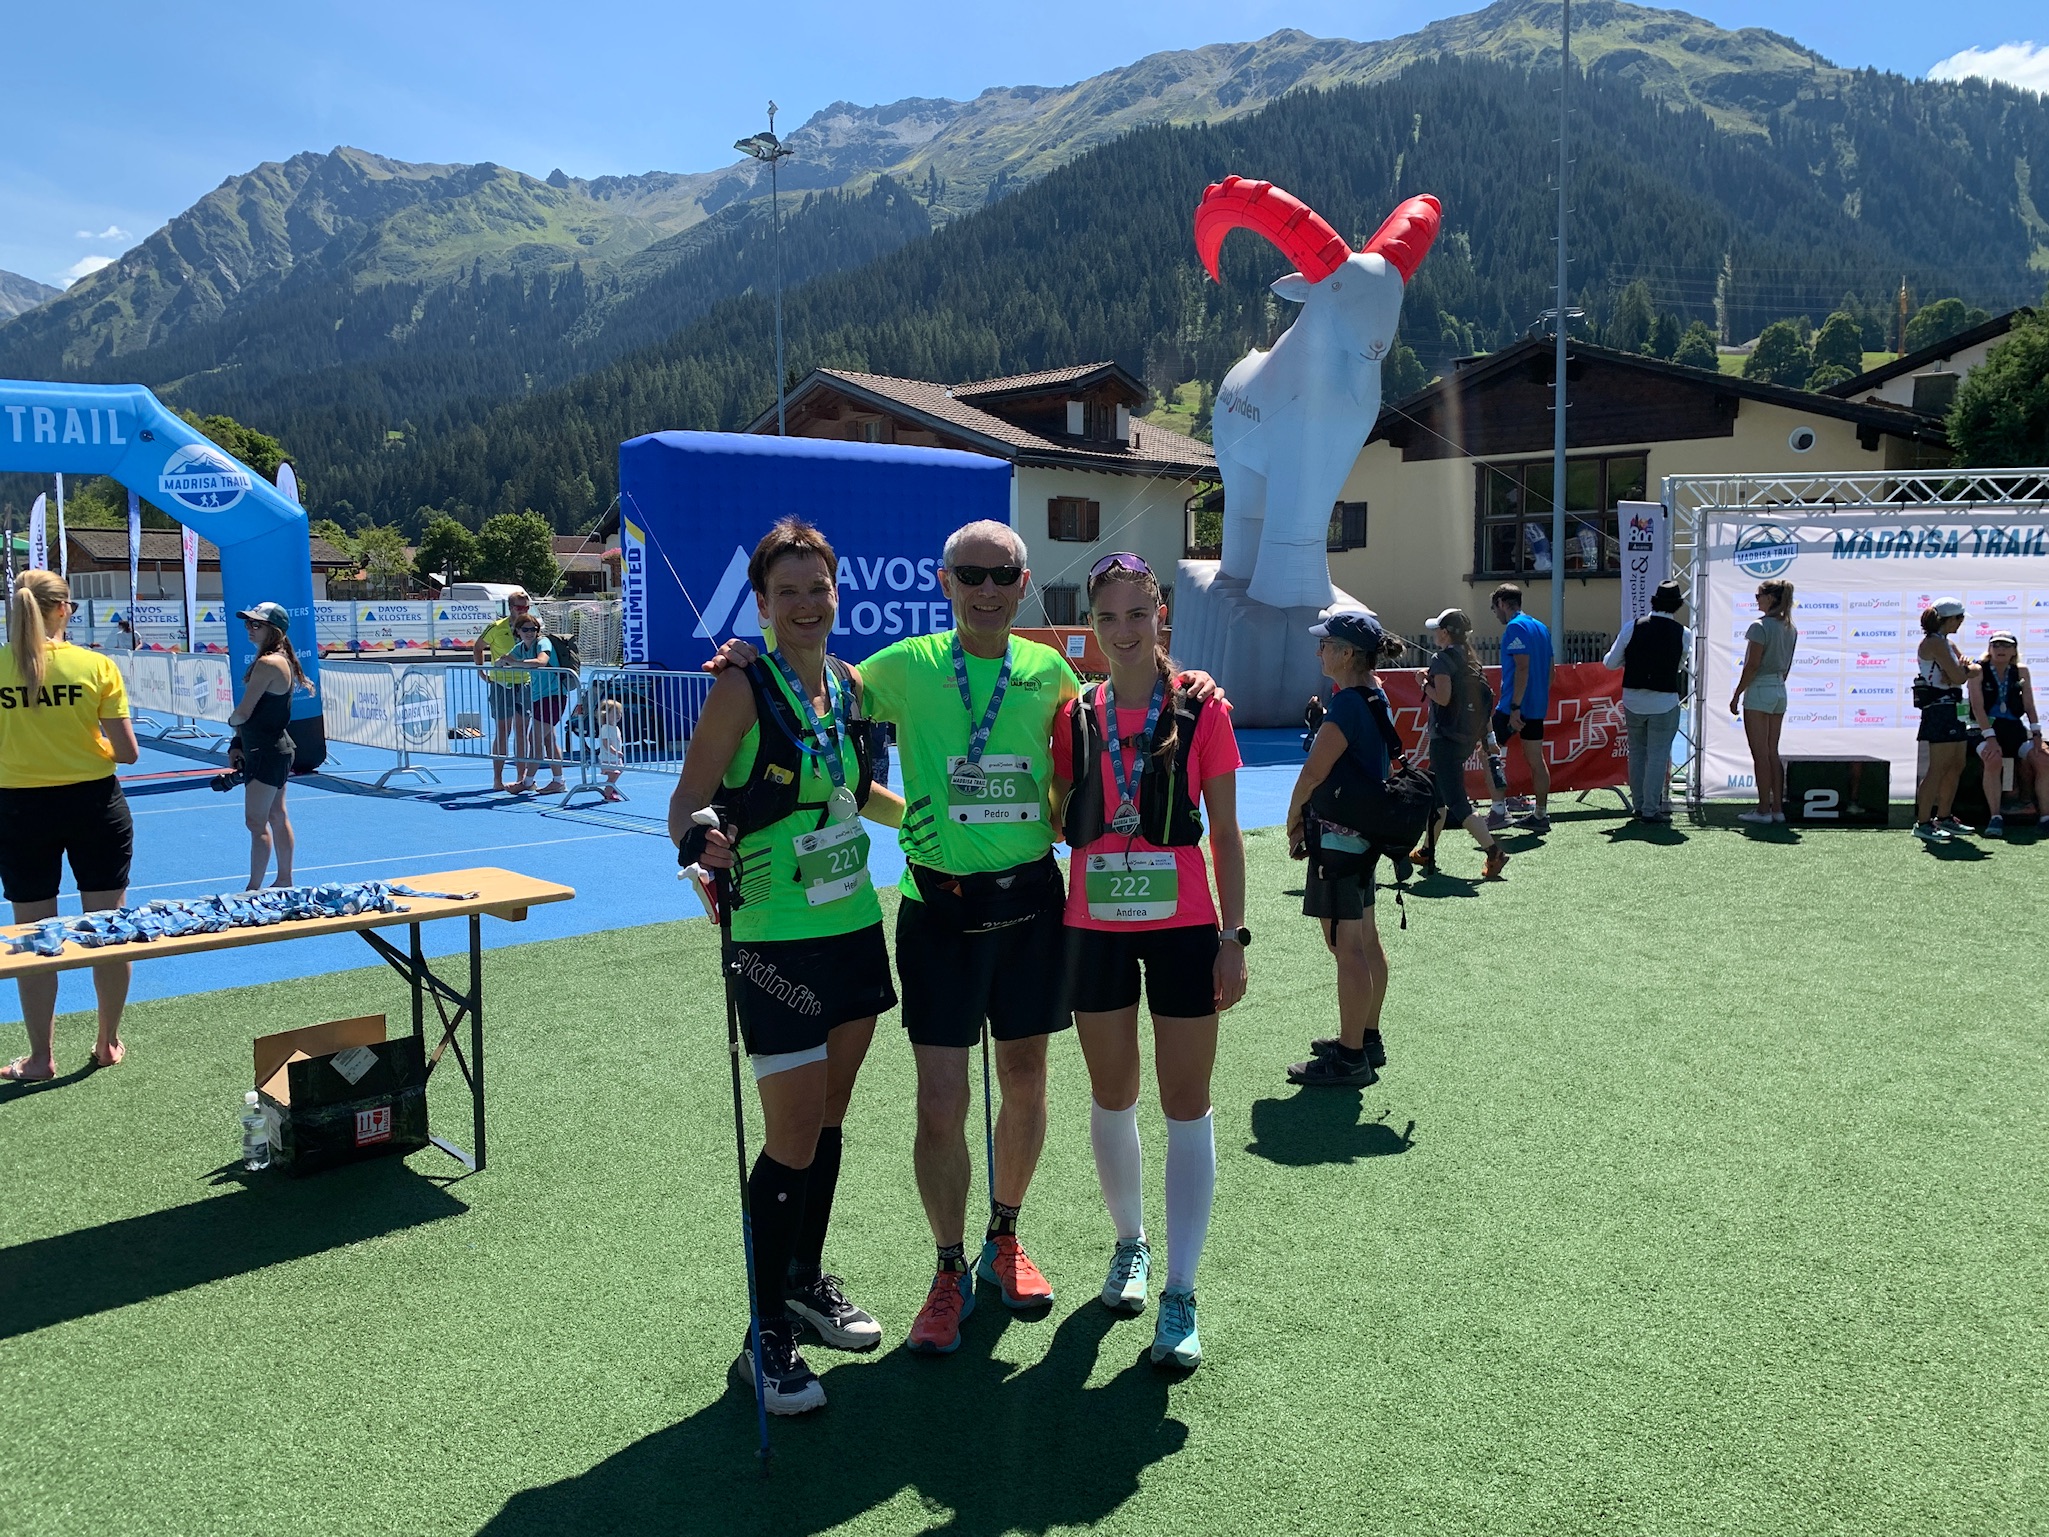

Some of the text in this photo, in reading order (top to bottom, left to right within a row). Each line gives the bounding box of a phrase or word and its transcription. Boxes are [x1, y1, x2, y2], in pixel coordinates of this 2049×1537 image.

[5, 405, 127, 445] TRAIL
[164, 475, 249, 490] MADRISA TRAIL
[1737, 546, 1795, 563] MADRISA TRAIL
[1831, 527, 2047, 560] MADRISA TRAIL
[836, 556, 937, 592] AVOS
[378, 605, 408, 613] DAVOS
[628, 548, 645, 663] UNLIMITED
[0, 685, 83, 710] STAFF
[952, 777, 973, 785] MADRISA
[984, 809, 1010, 819] Pedro
[1803, 788, 1840, 819] 2
[827, 844, 860, 874] 221
[1109, 875, 1151, 897] 222
[1116, 907, 1147, 917] Andrea
[737, 948, 822, 1017] skinfit
